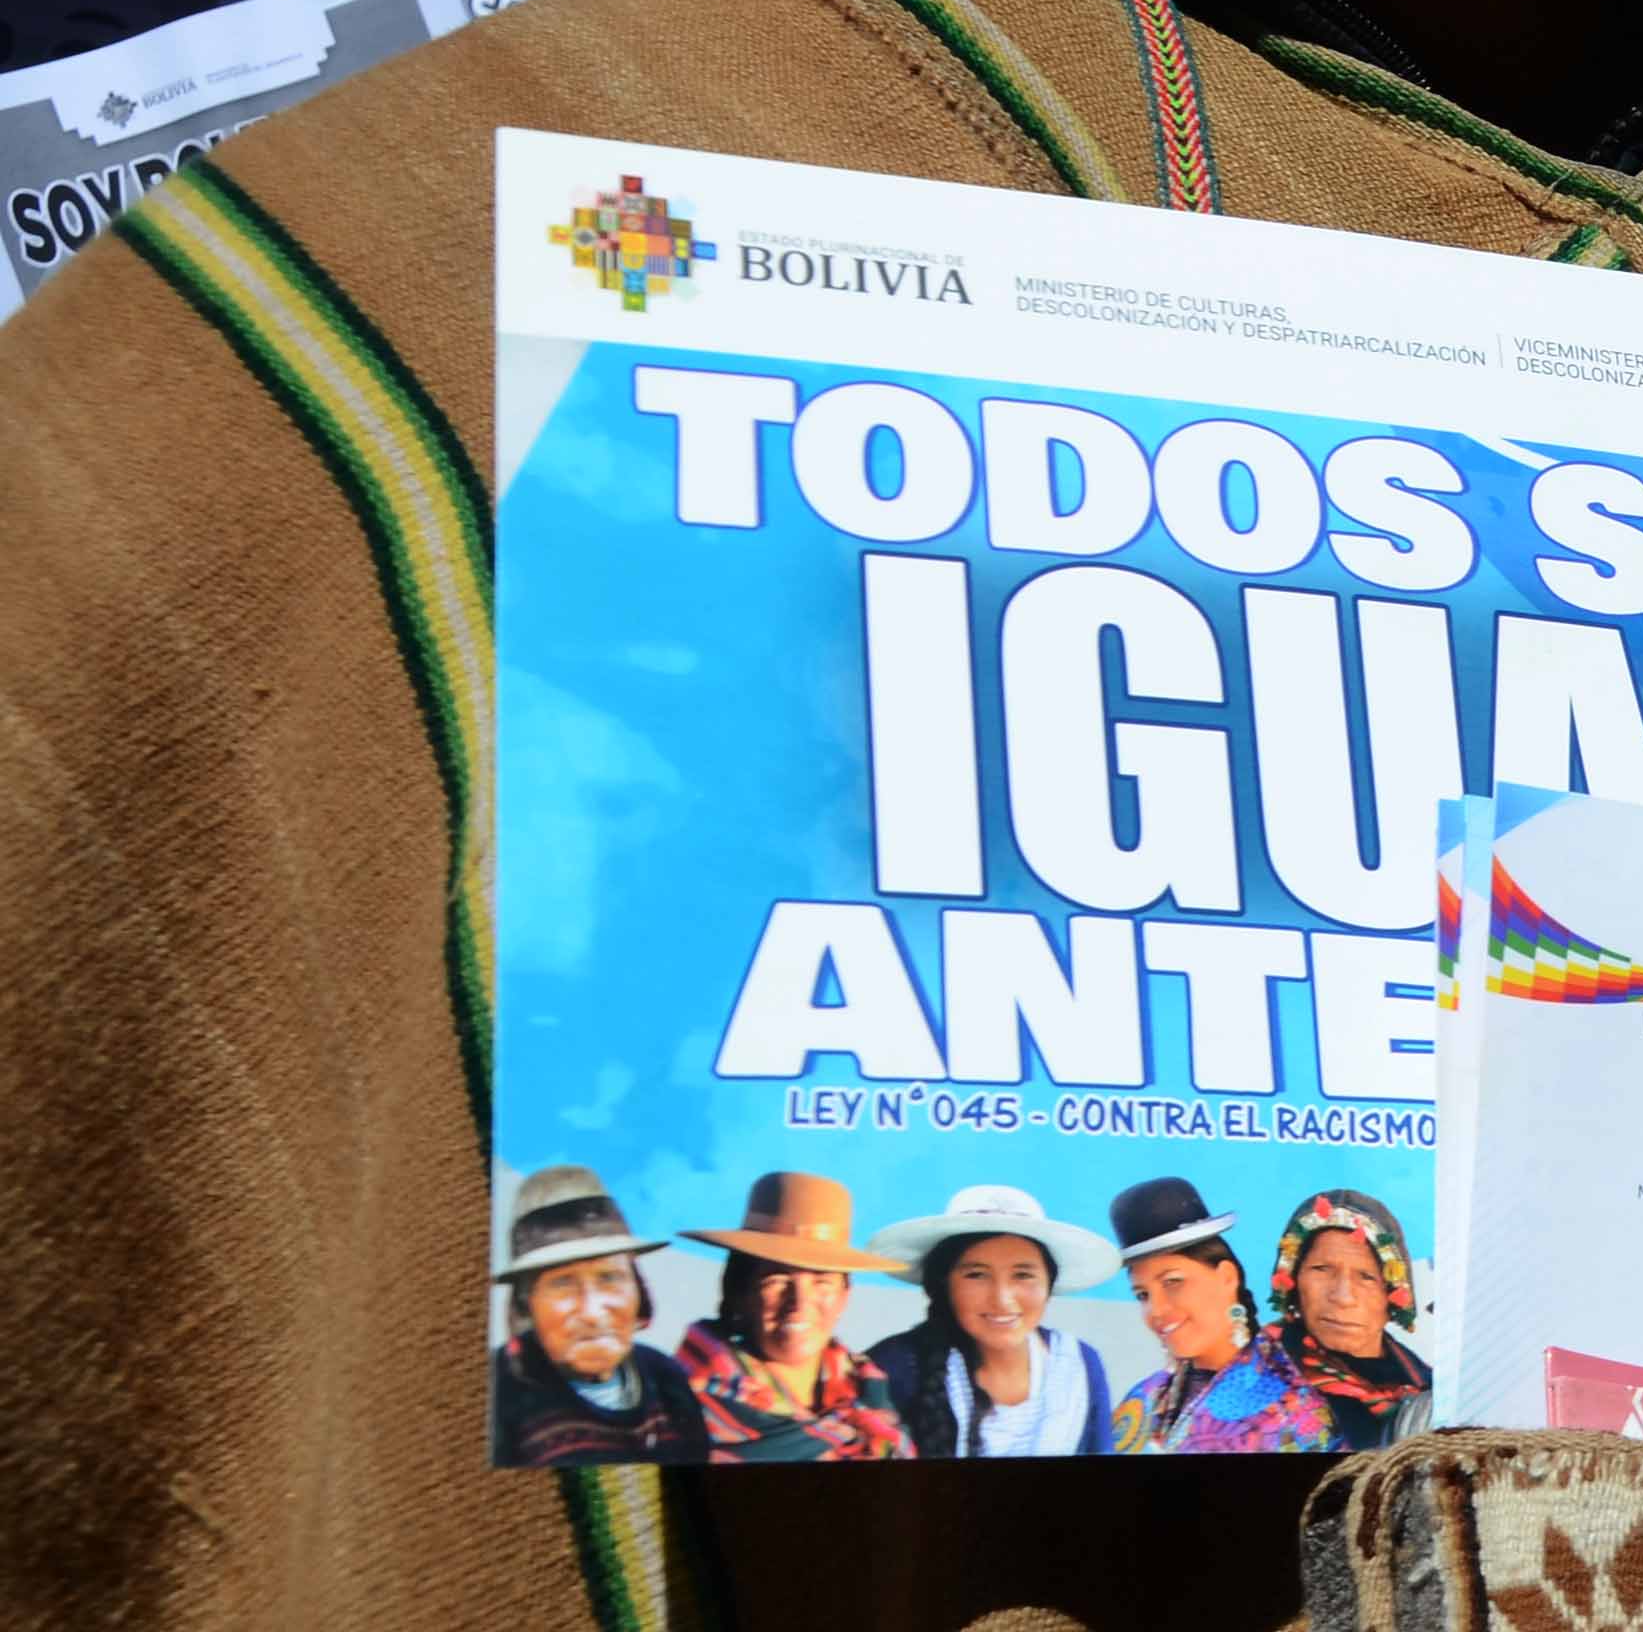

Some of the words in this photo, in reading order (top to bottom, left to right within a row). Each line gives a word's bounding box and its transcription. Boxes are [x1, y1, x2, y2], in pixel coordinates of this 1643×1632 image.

[12, 171, 123, 264] SOY
[739, 244, 974, 306] BOLIVIA
[1015, 275, 1138, 306] MINISTERIO
[1144, 290, 1173, 309] DE
[1178, 294, 1292, 325] CULTURAS,
[1016, 295, 1217, 335] DESCOLONIZACIÓN
[1224, 321, 1237, 337] Y
[1242, 321, 1487, 367] DESPATRIARCALIZACIÓN
[634, 364, 1478, 593] TODOS
[714, 899, 1436, 1102] ANTE
[788, 1090, 864, 1125] LEY
[933, 1093, 1020, 1128] 045
[1057, 1097, 1211, 1134] CONTRA
[1225, 1104, 1264, 1137] EL
[1278, 1107, 1435, 1146] RACISMO
